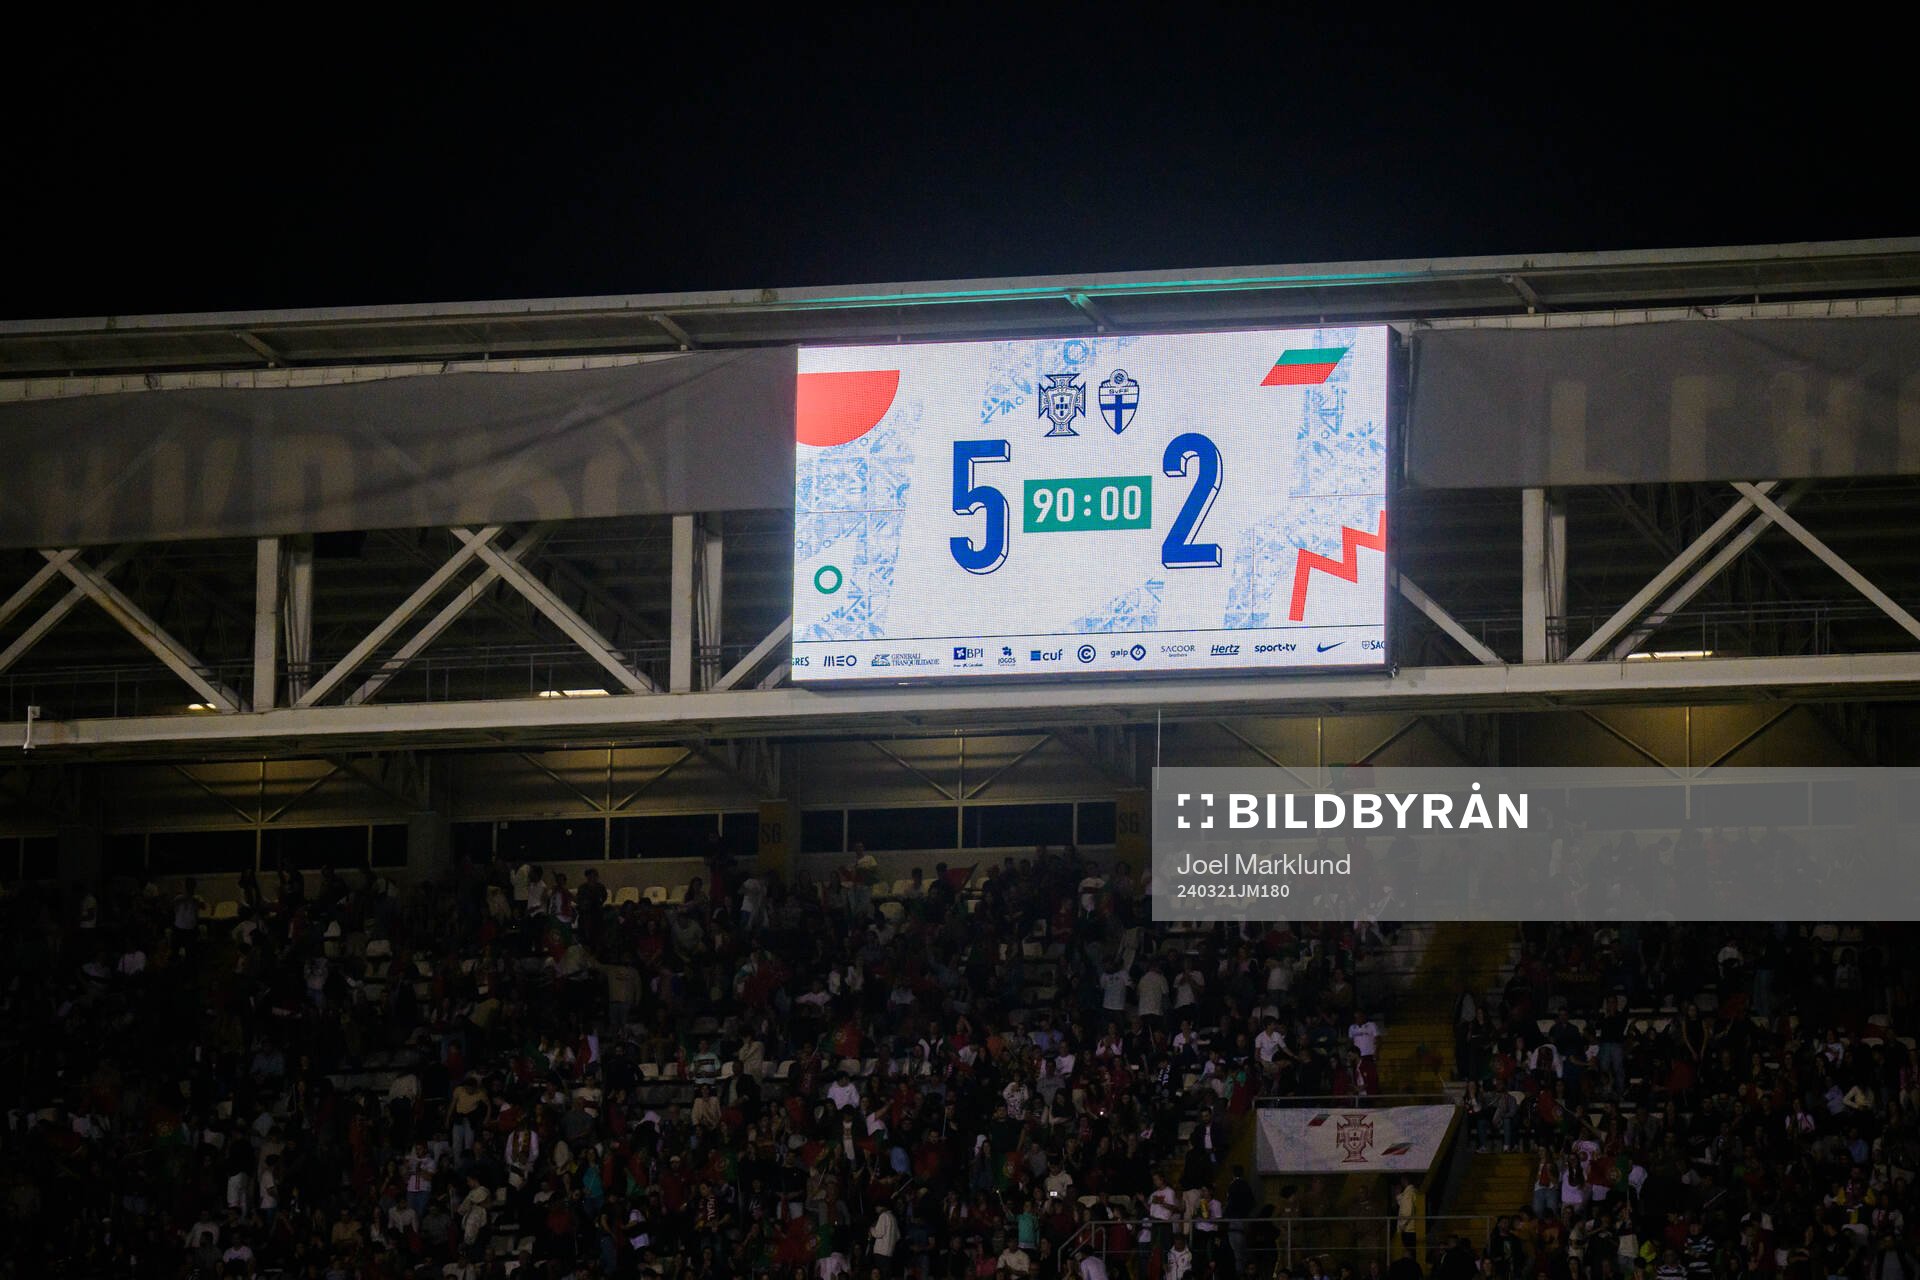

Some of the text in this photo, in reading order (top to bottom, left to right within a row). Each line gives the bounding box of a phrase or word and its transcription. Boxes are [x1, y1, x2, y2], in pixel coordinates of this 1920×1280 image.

[950, 432, 1223, 575] 5 90:00 2
[967, 648, 984, 659] BPI
[1110, 648, 1129, 658] galp
[1161, 644, 1196, 653] SACOOR
[1210, 644, 1240, 654] Hertz
[1042, 649, 1063, 661] cuf
[824, 655, 857, 667] MEO
